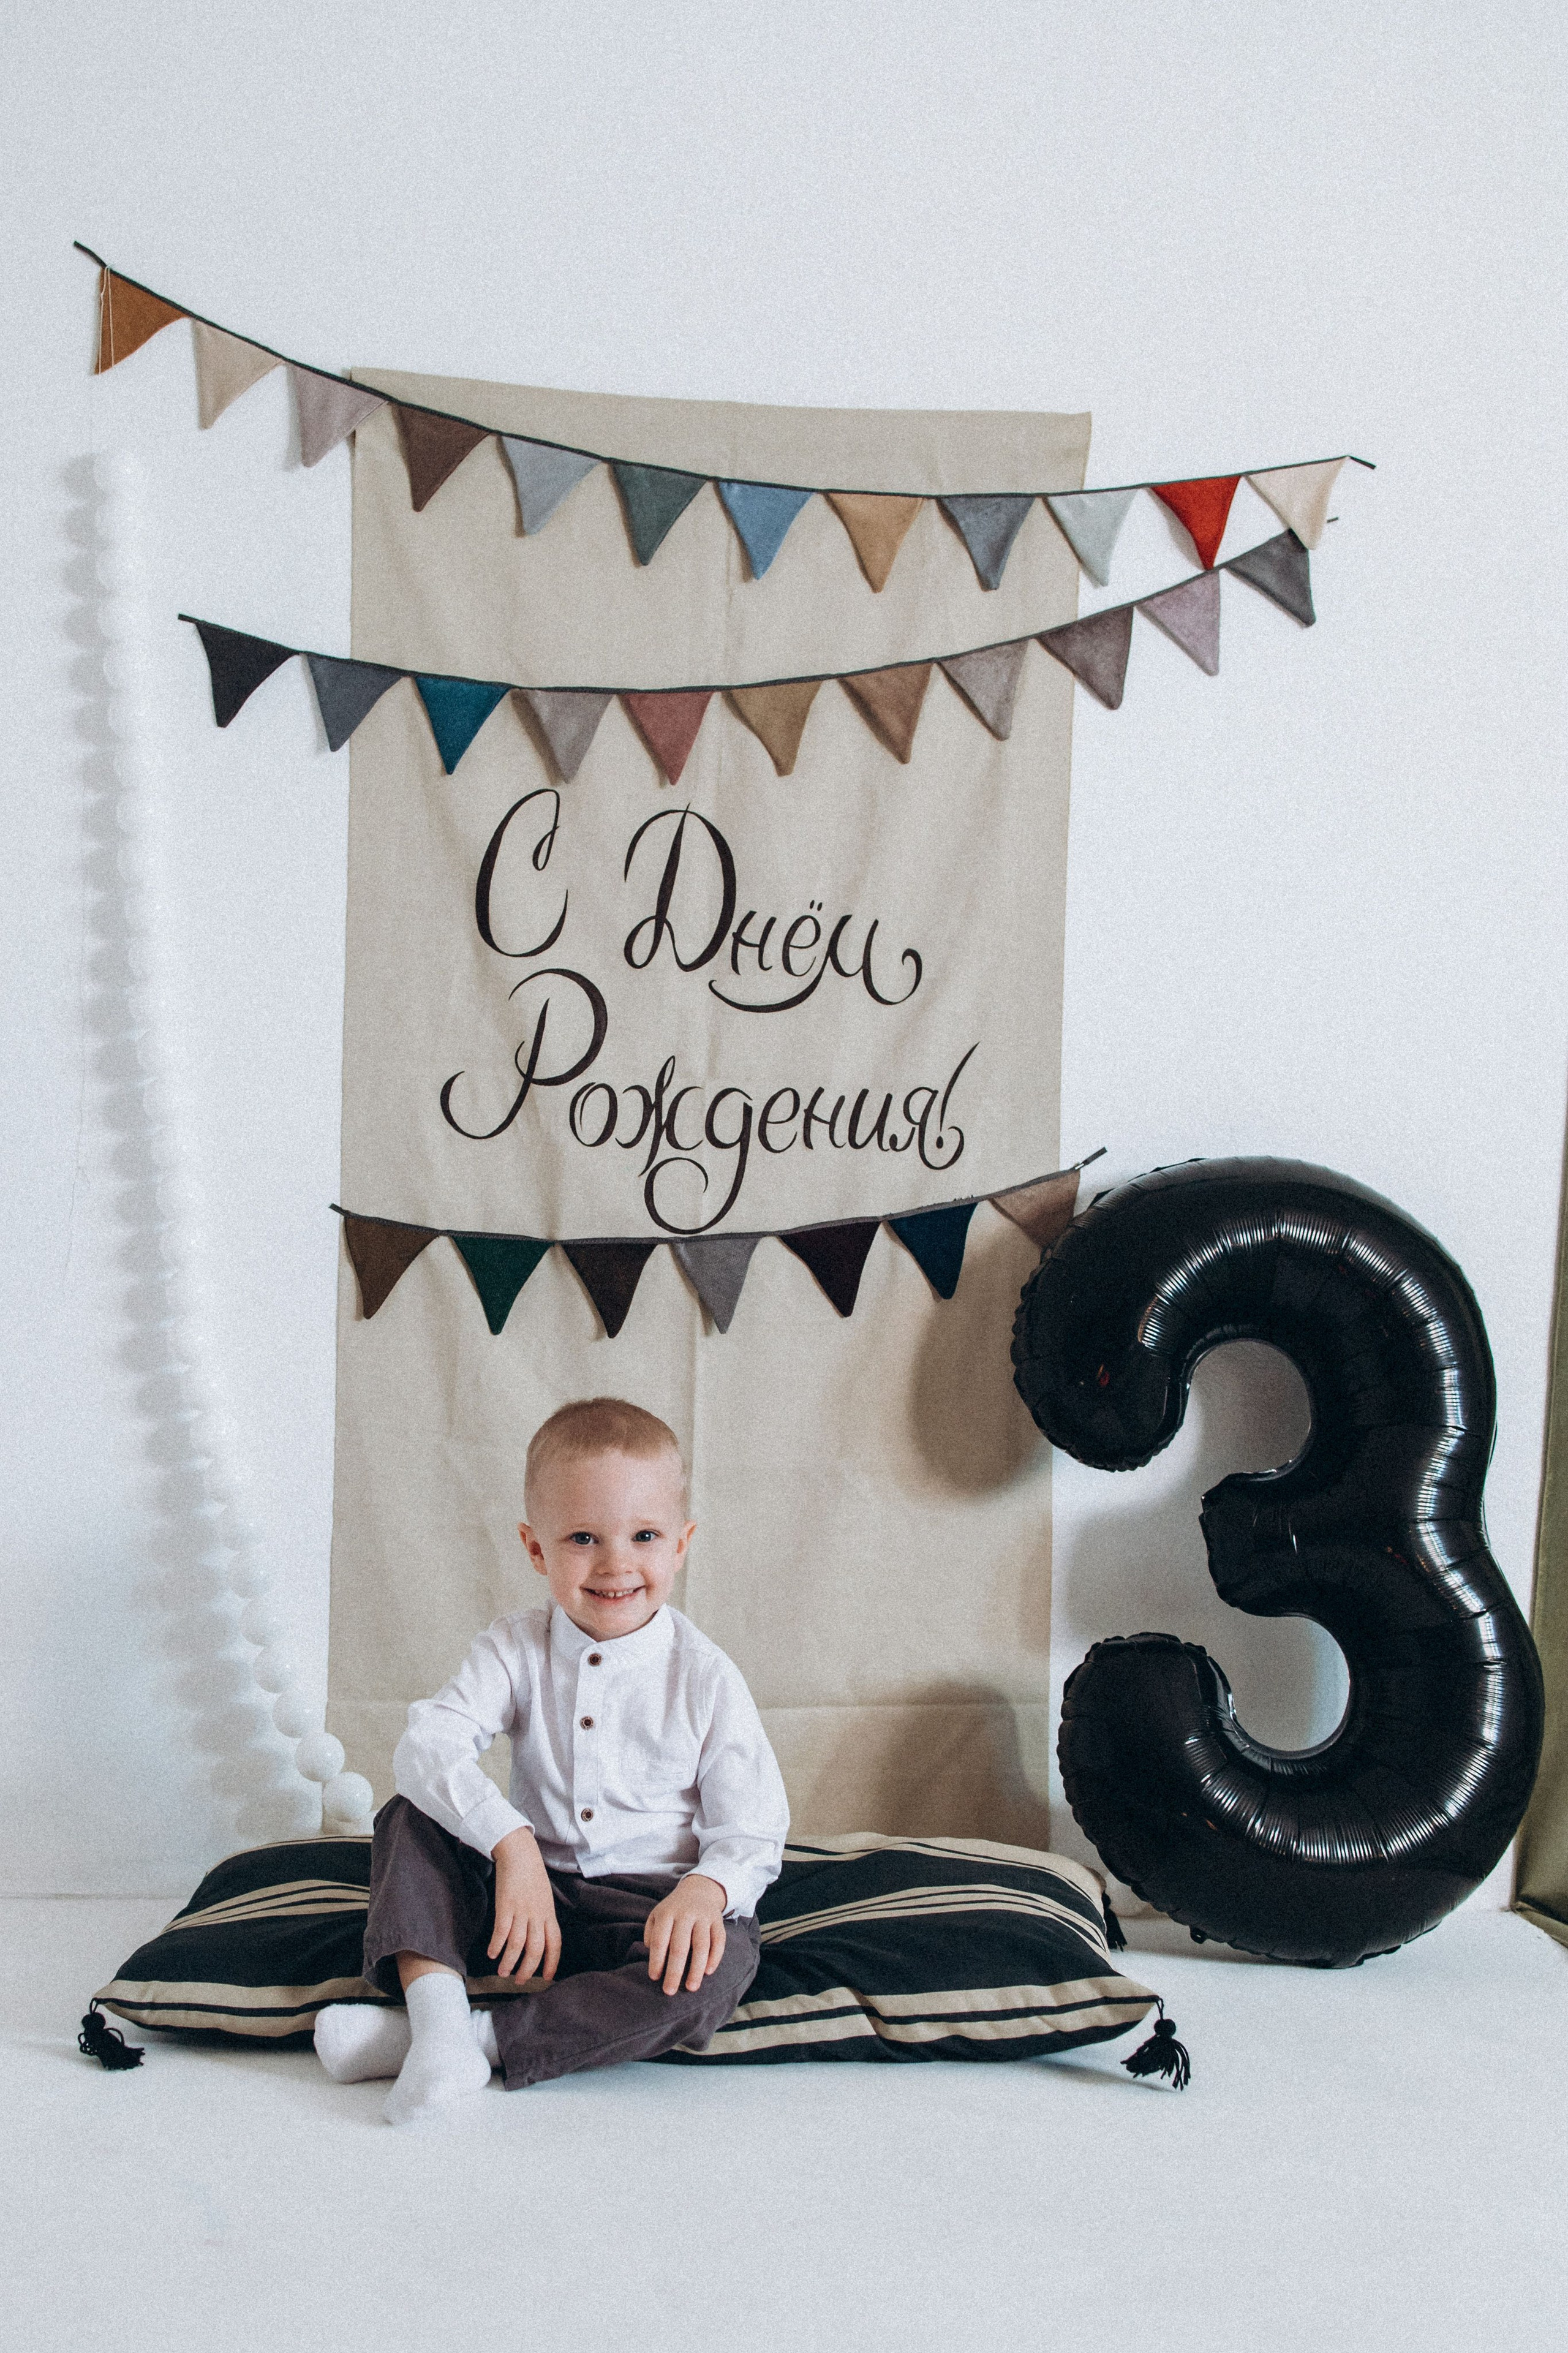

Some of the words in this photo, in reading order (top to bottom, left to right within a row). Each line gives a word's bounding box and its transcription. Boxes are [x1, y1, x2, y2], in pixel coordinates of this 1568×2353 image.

[475, 788, 568, 957] С
[624, 802, 922, 1013] Днём
[440, 968, 980, 1235] Рождения!
[1012, 1155, 1544, 1968] 3
